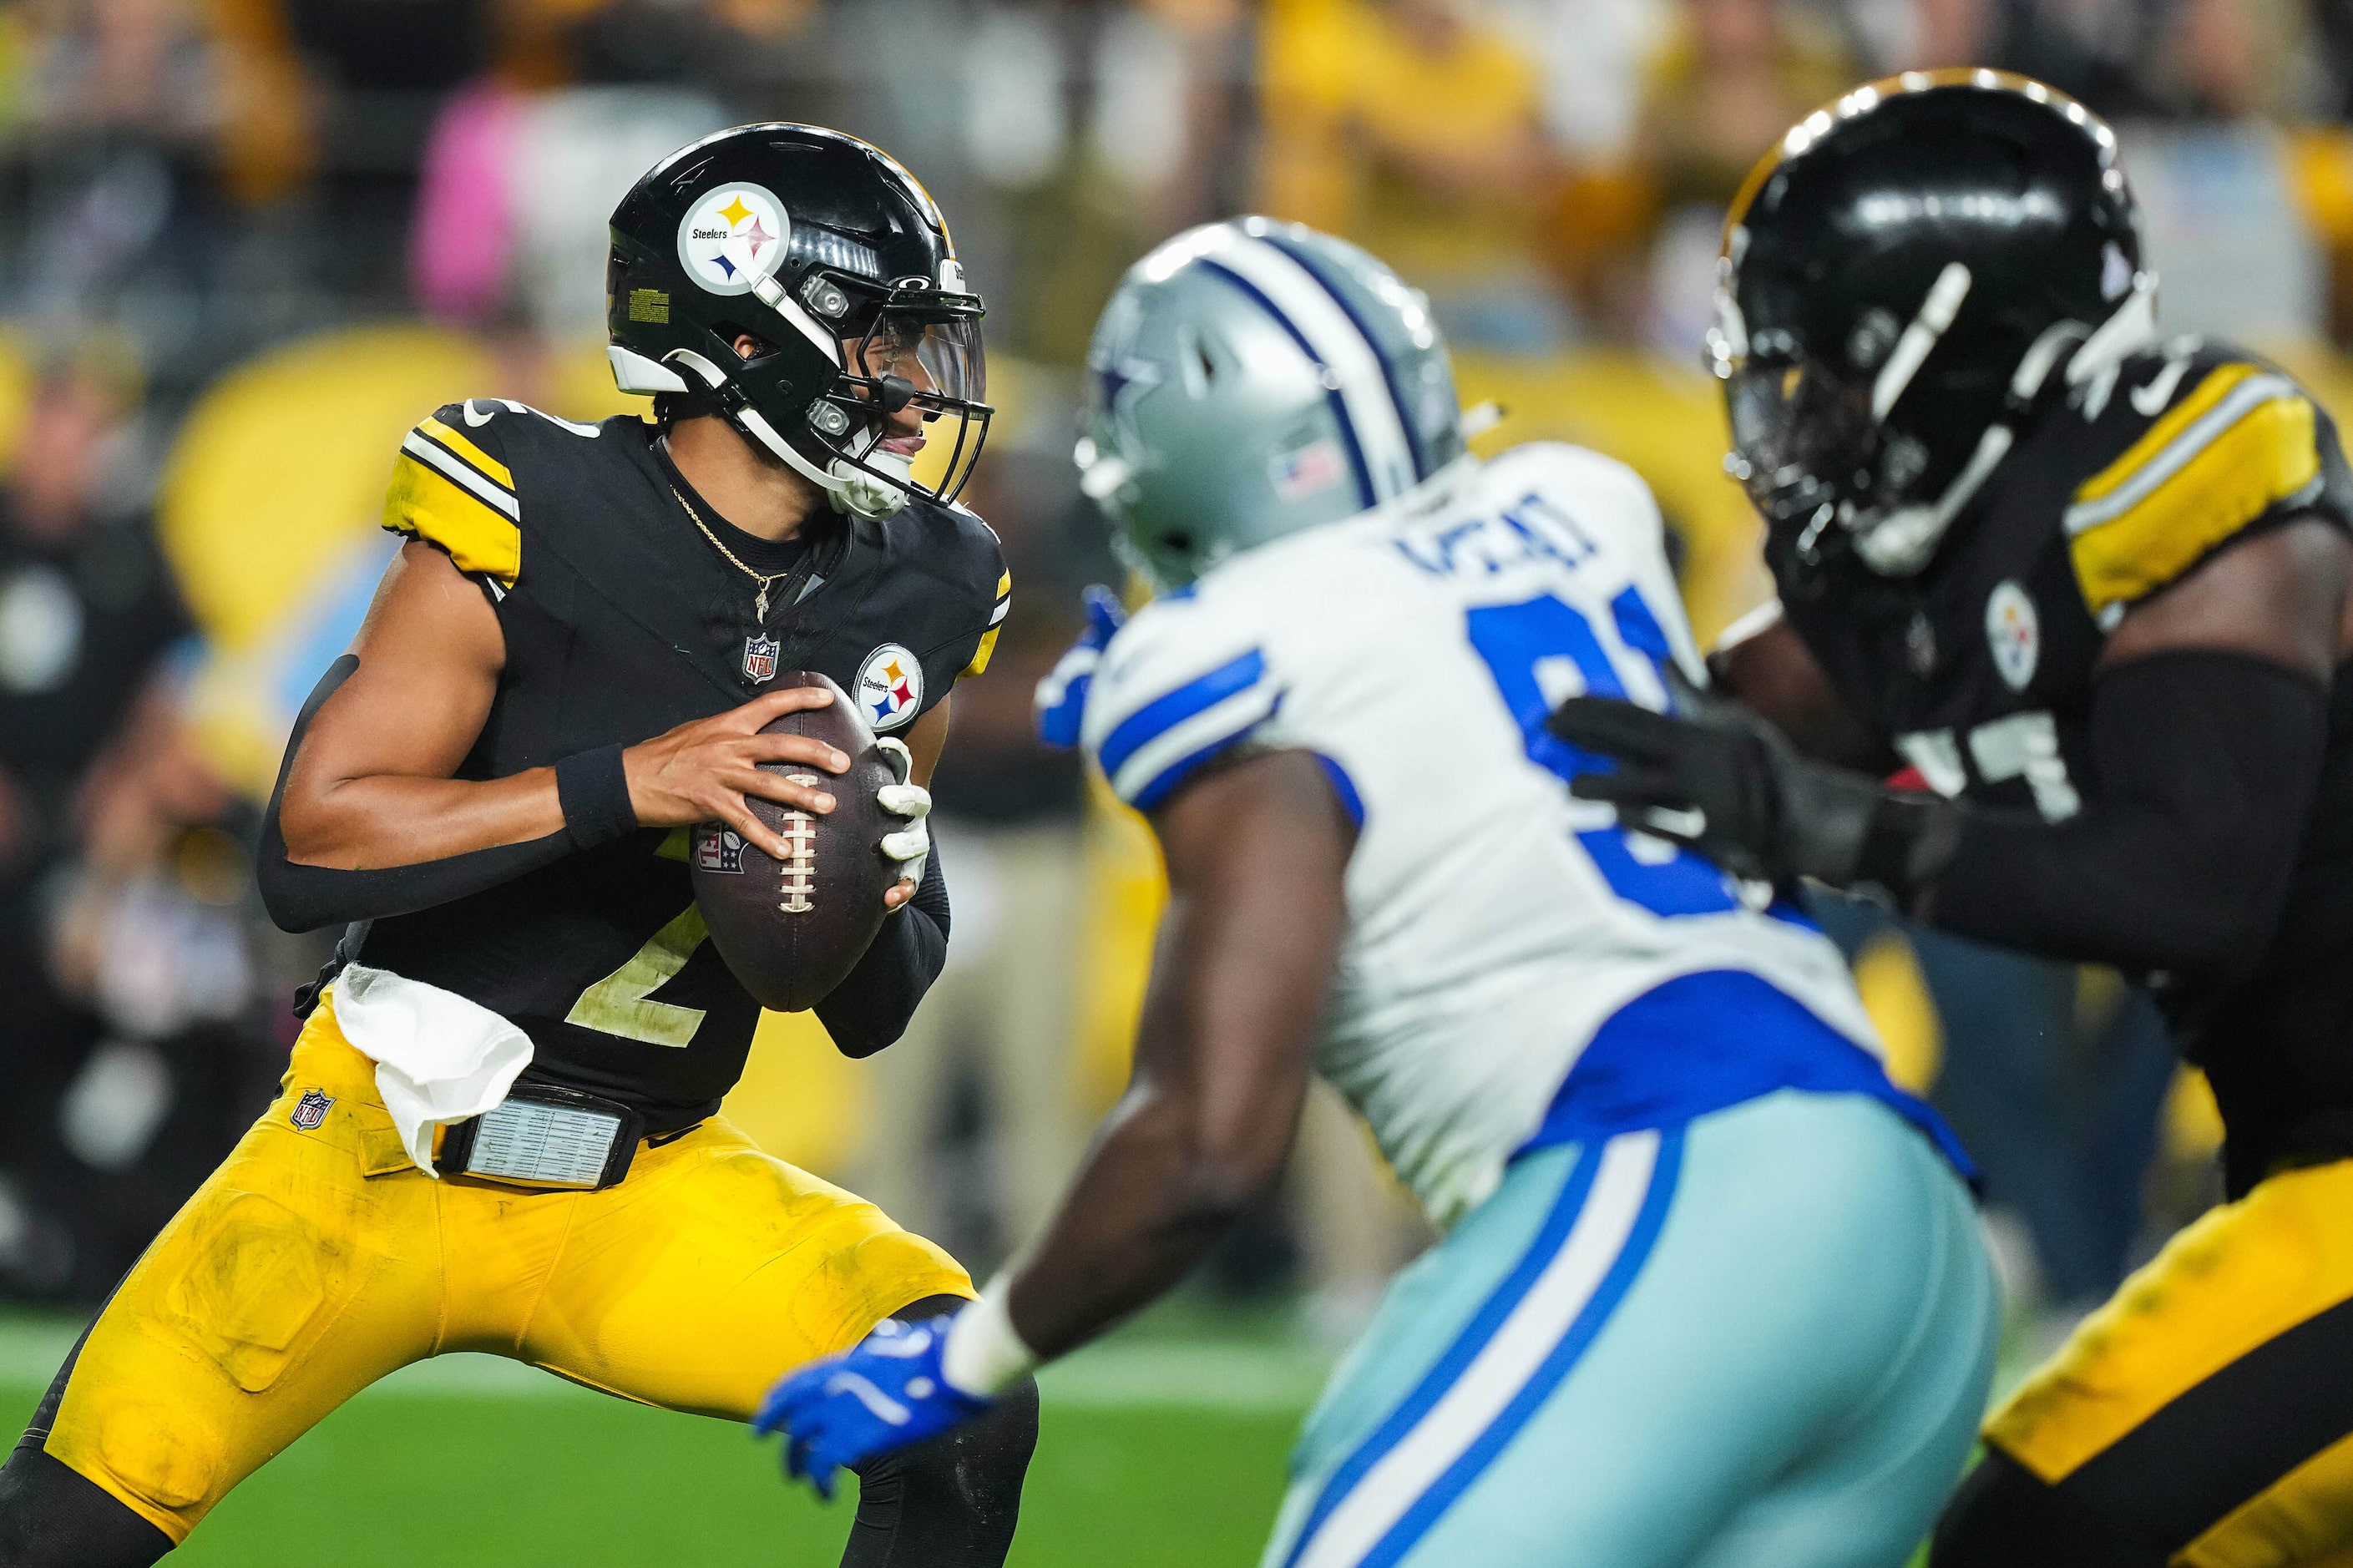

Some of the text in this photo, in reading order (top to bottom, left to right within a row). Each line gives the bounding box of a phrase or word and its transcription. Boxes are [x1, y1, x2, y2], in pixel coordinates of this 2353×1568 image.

[692, 228, 728, 239] Steelers
[747, 655, 772, 675] NFL
[863, 676, 888, 693] Steelers
[699, 833, 720, 865] FL
[295, 1105, 320, 1123] NFL
